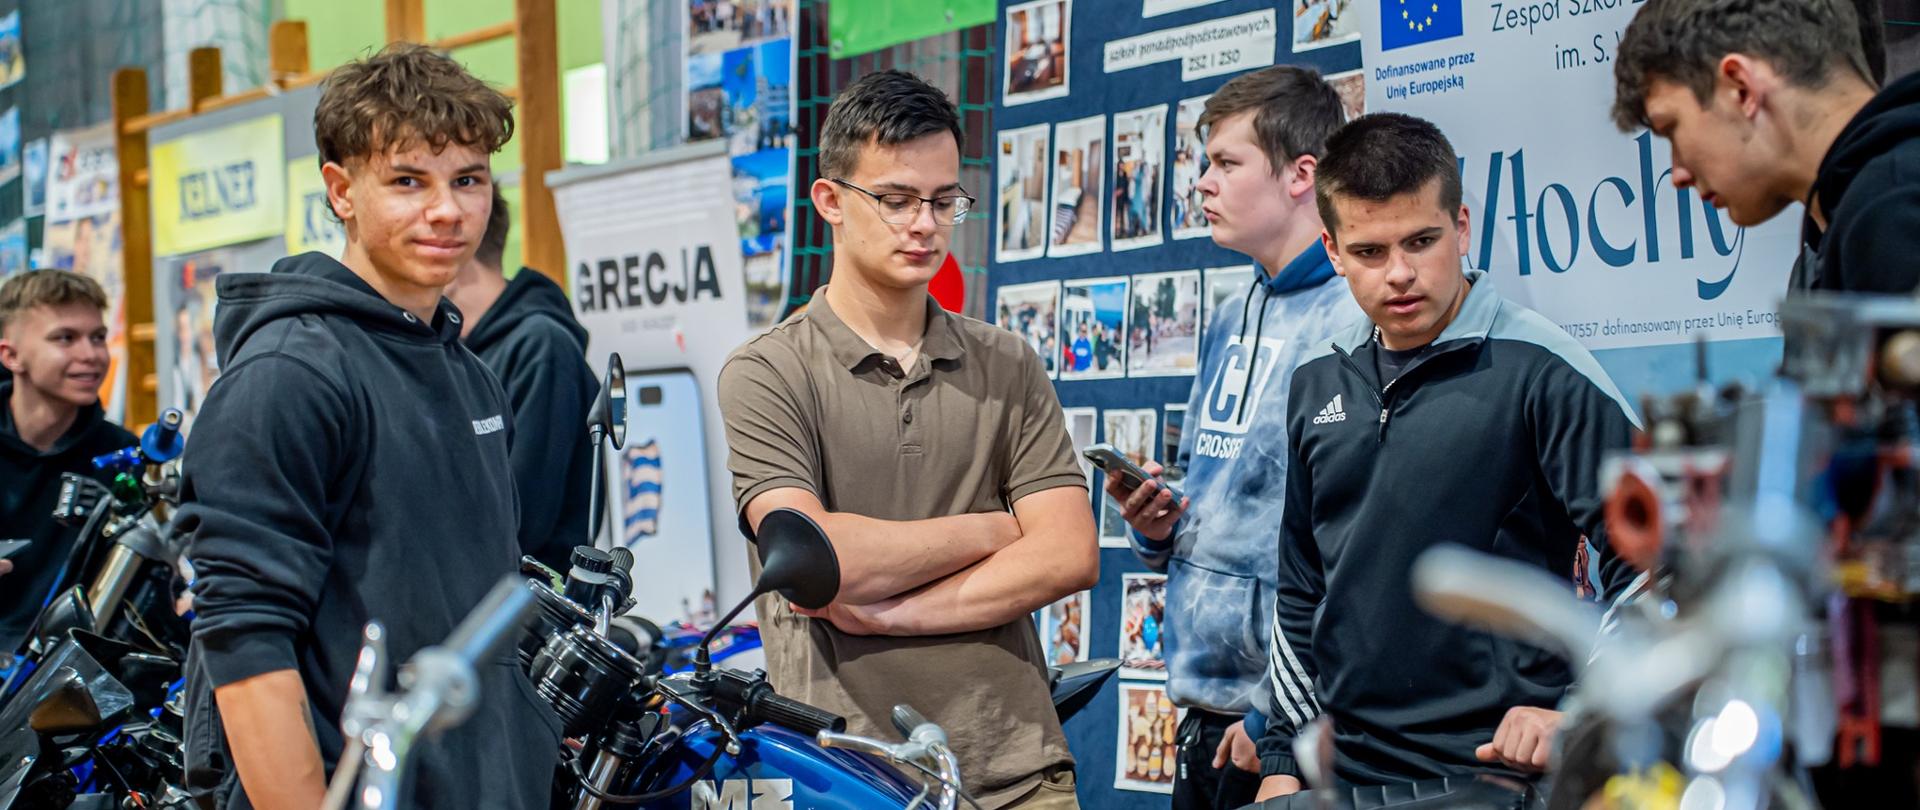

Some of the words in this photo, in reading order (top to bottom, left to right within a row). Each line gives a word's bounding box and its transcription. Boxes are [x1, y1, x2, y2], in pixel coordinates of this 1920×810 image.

[1375, 57, 1446, 81] Dofinansowane
[1448, 51, 1475, 67] przez
[1554, 44, 1587, 70] im.
[1593, 34, 1610, 64] S.
[1386, 83, 1407, 100] Unię
[1409, 74, 1464, 96] Europejską
[577, 245, 723, 313] GRECJA
[1602, 317, 1681, 337] dofinansowany
[1684, 318, 1714, 333] przez
[1717, 311, 1743, 329] Unię
[1747, 309, 1780, 328] Europ
[1313, 412, 1346, 425] adidas
